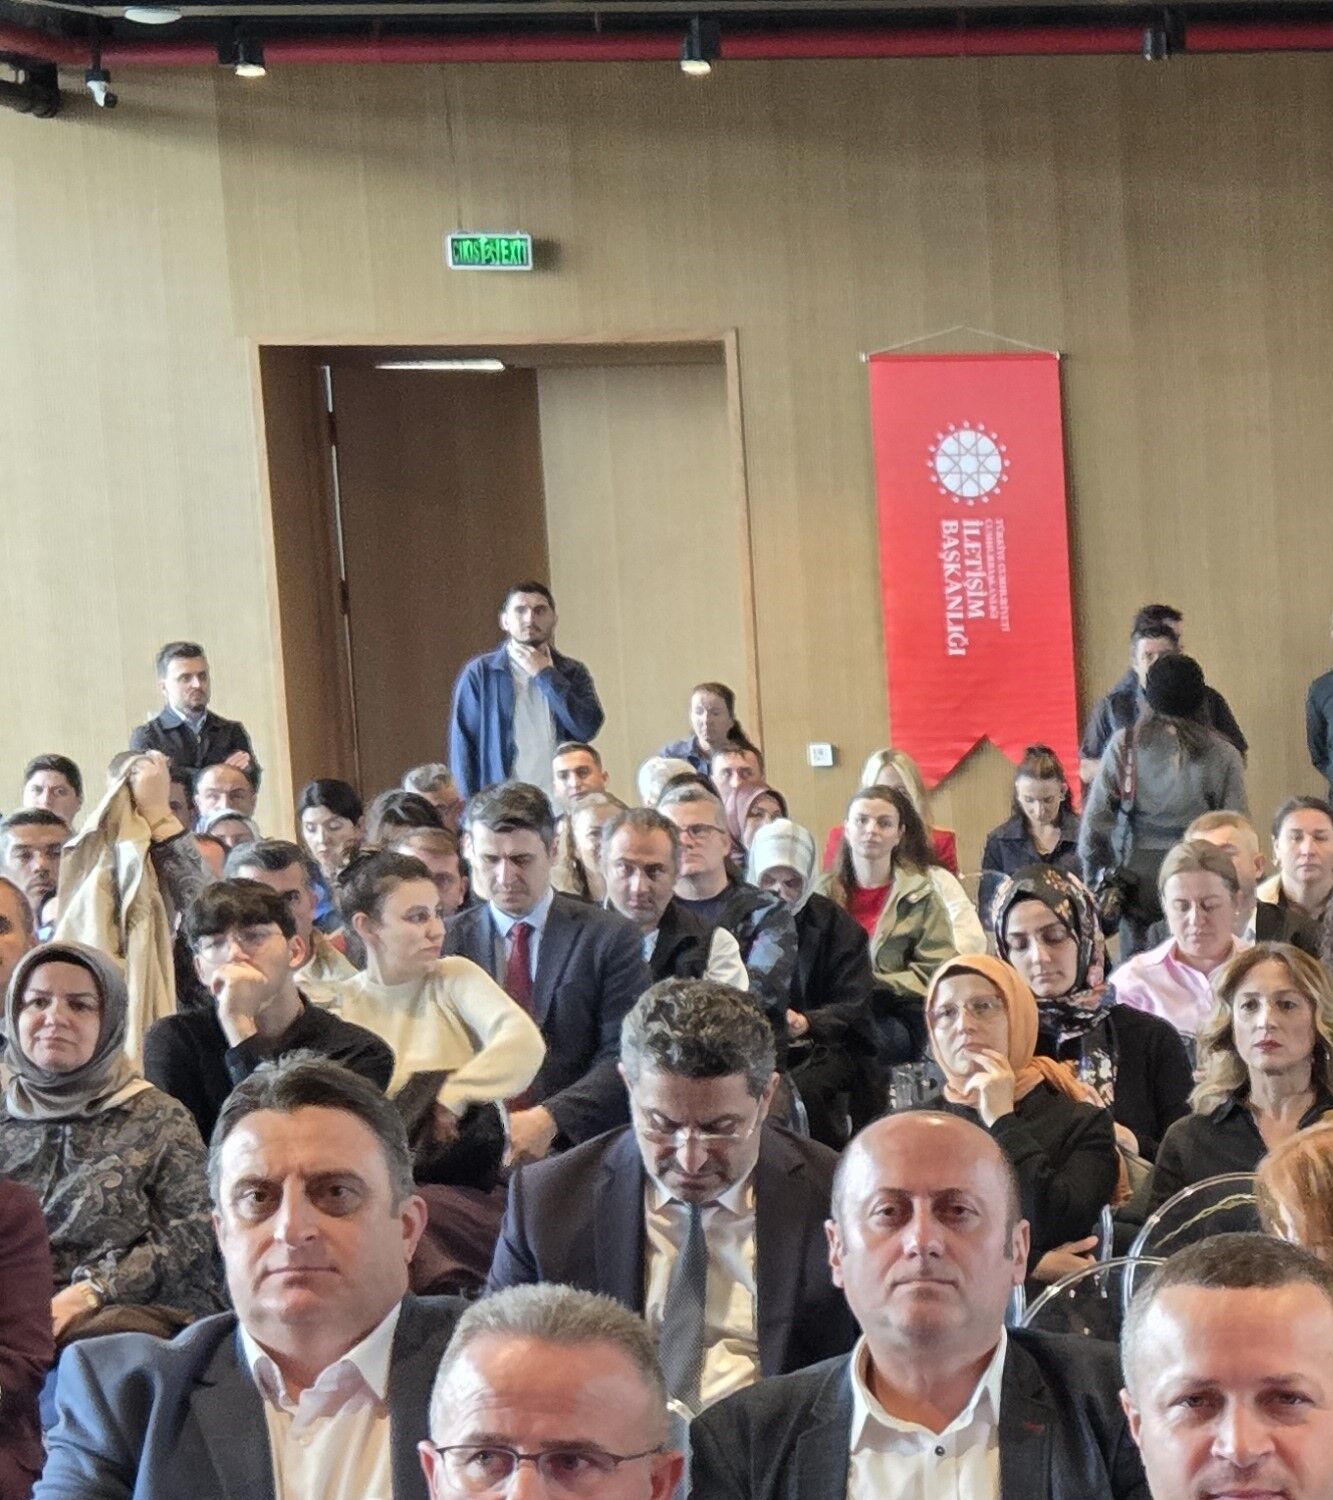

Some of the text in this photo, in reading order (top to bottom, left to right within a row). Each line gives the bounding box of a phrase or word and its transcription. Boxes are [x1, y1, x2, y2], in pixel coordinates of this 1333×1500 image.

[502, 239, 528, 265] EXIT
[938, 519, 969, 656] BAŞKANLIĞI
[964, 518, 987, 619] İLETİŞİM
